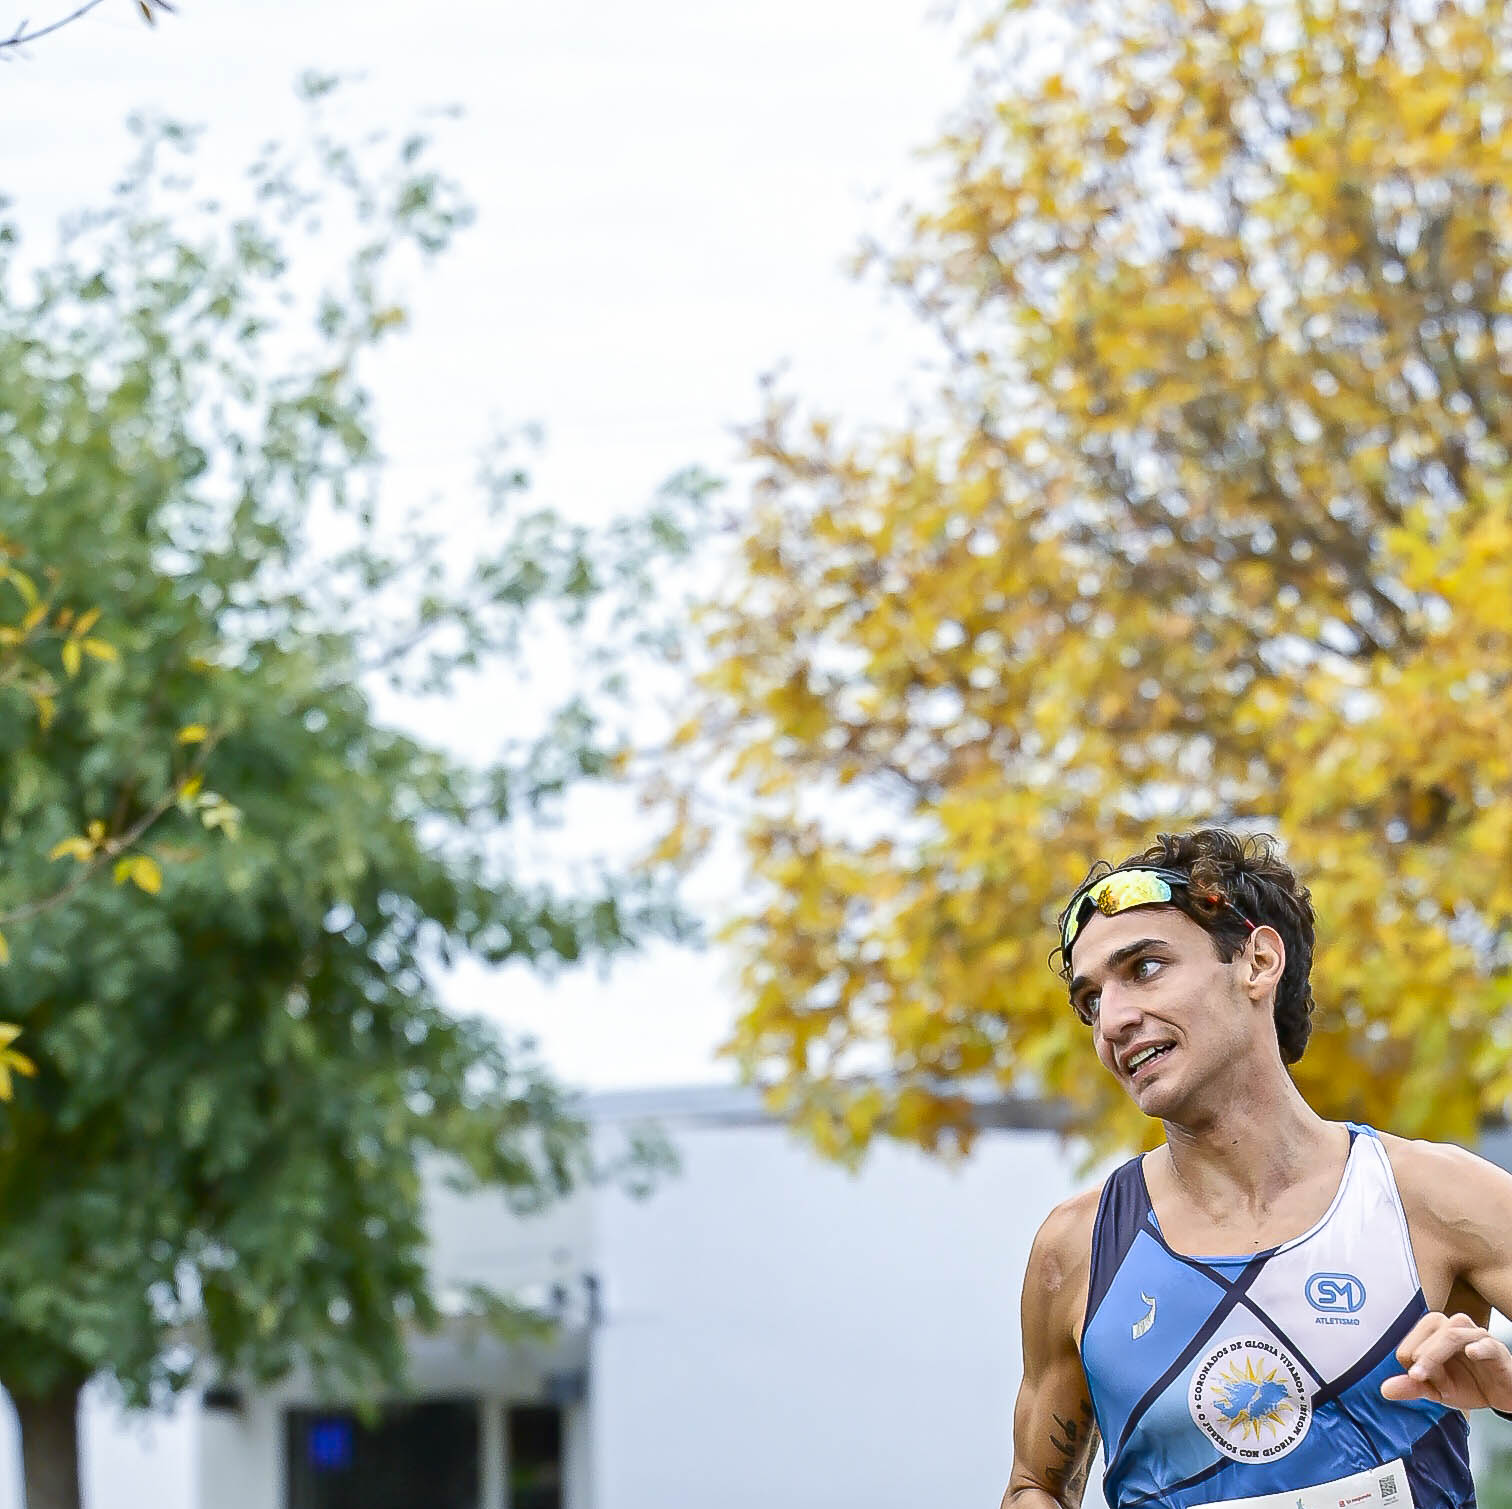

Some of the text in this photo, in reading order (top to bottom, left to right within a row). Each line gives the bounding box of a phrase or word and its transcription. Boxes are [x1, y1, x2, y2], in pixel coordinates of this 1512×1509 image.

[1315, 1317, 1360, 1326] ATLETISMO
[1194, 1340, 1305, 1401] CORONADOS DE GLORIA VIVAMOS
[1198, 1413, 1206, 1421] O
[1202, 1421, 1238, 1454] JUREMOS
[1239, 1449, 1260, 1458] CON
[1262, 1435, 1296, 1457] GLORIA
